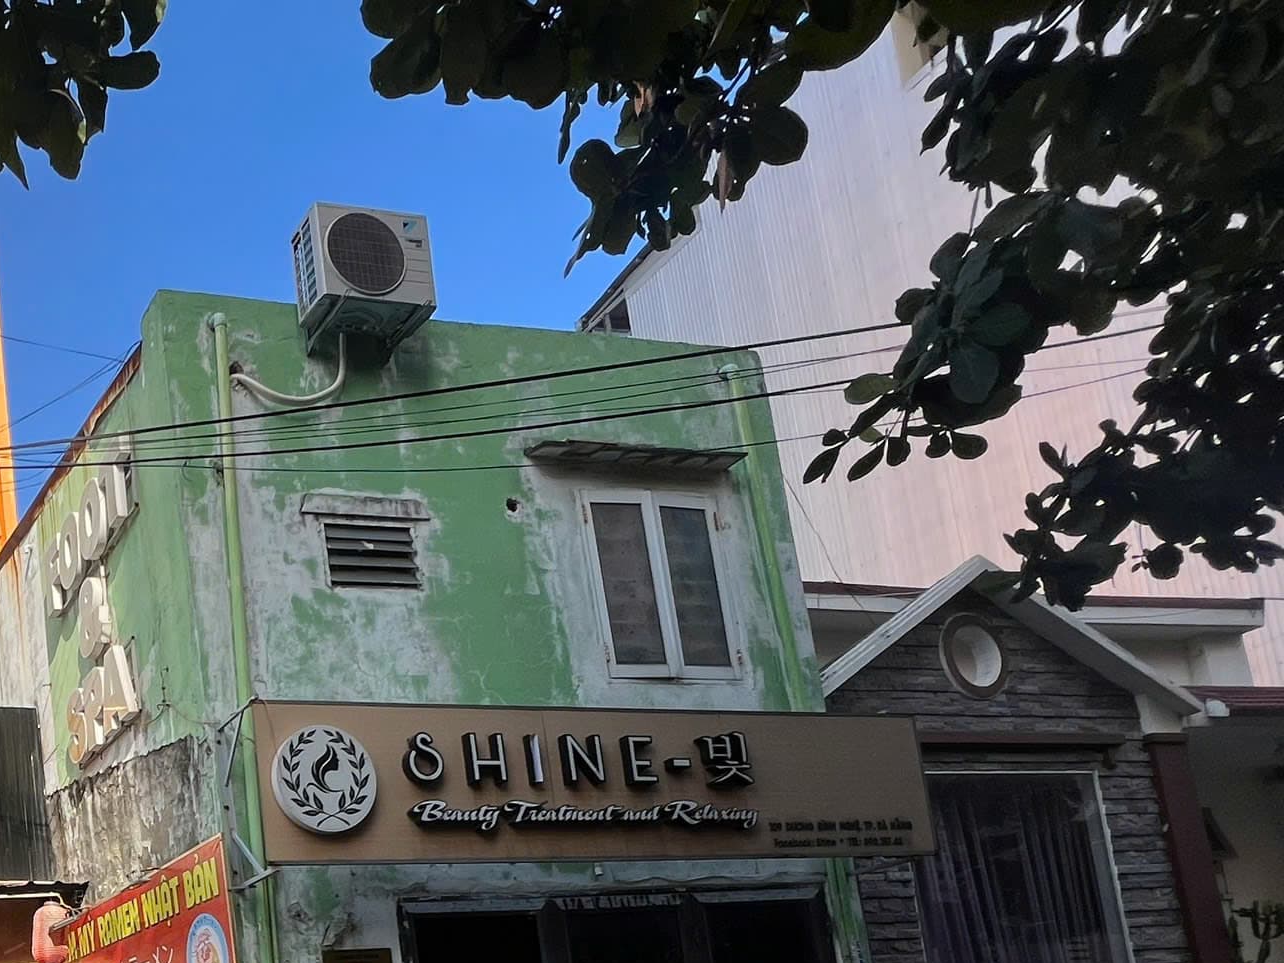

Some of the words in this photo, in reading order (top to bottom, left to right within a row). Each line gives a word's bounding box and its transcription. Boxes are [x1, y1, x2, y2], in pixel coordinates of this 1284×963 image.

[67, 645, 139, 764] SPA
[412, 800, 501, 831] Beauty
[504, 800, 621, 824] Treatment
[619, 806, 660, 822] and
[665, 800, 758, 830] Relaxing
[97, 898, 142, 948] RAMEN
[140, 874, 181, 928] NHẬT
[182, 853, 219, 909] BẢN
